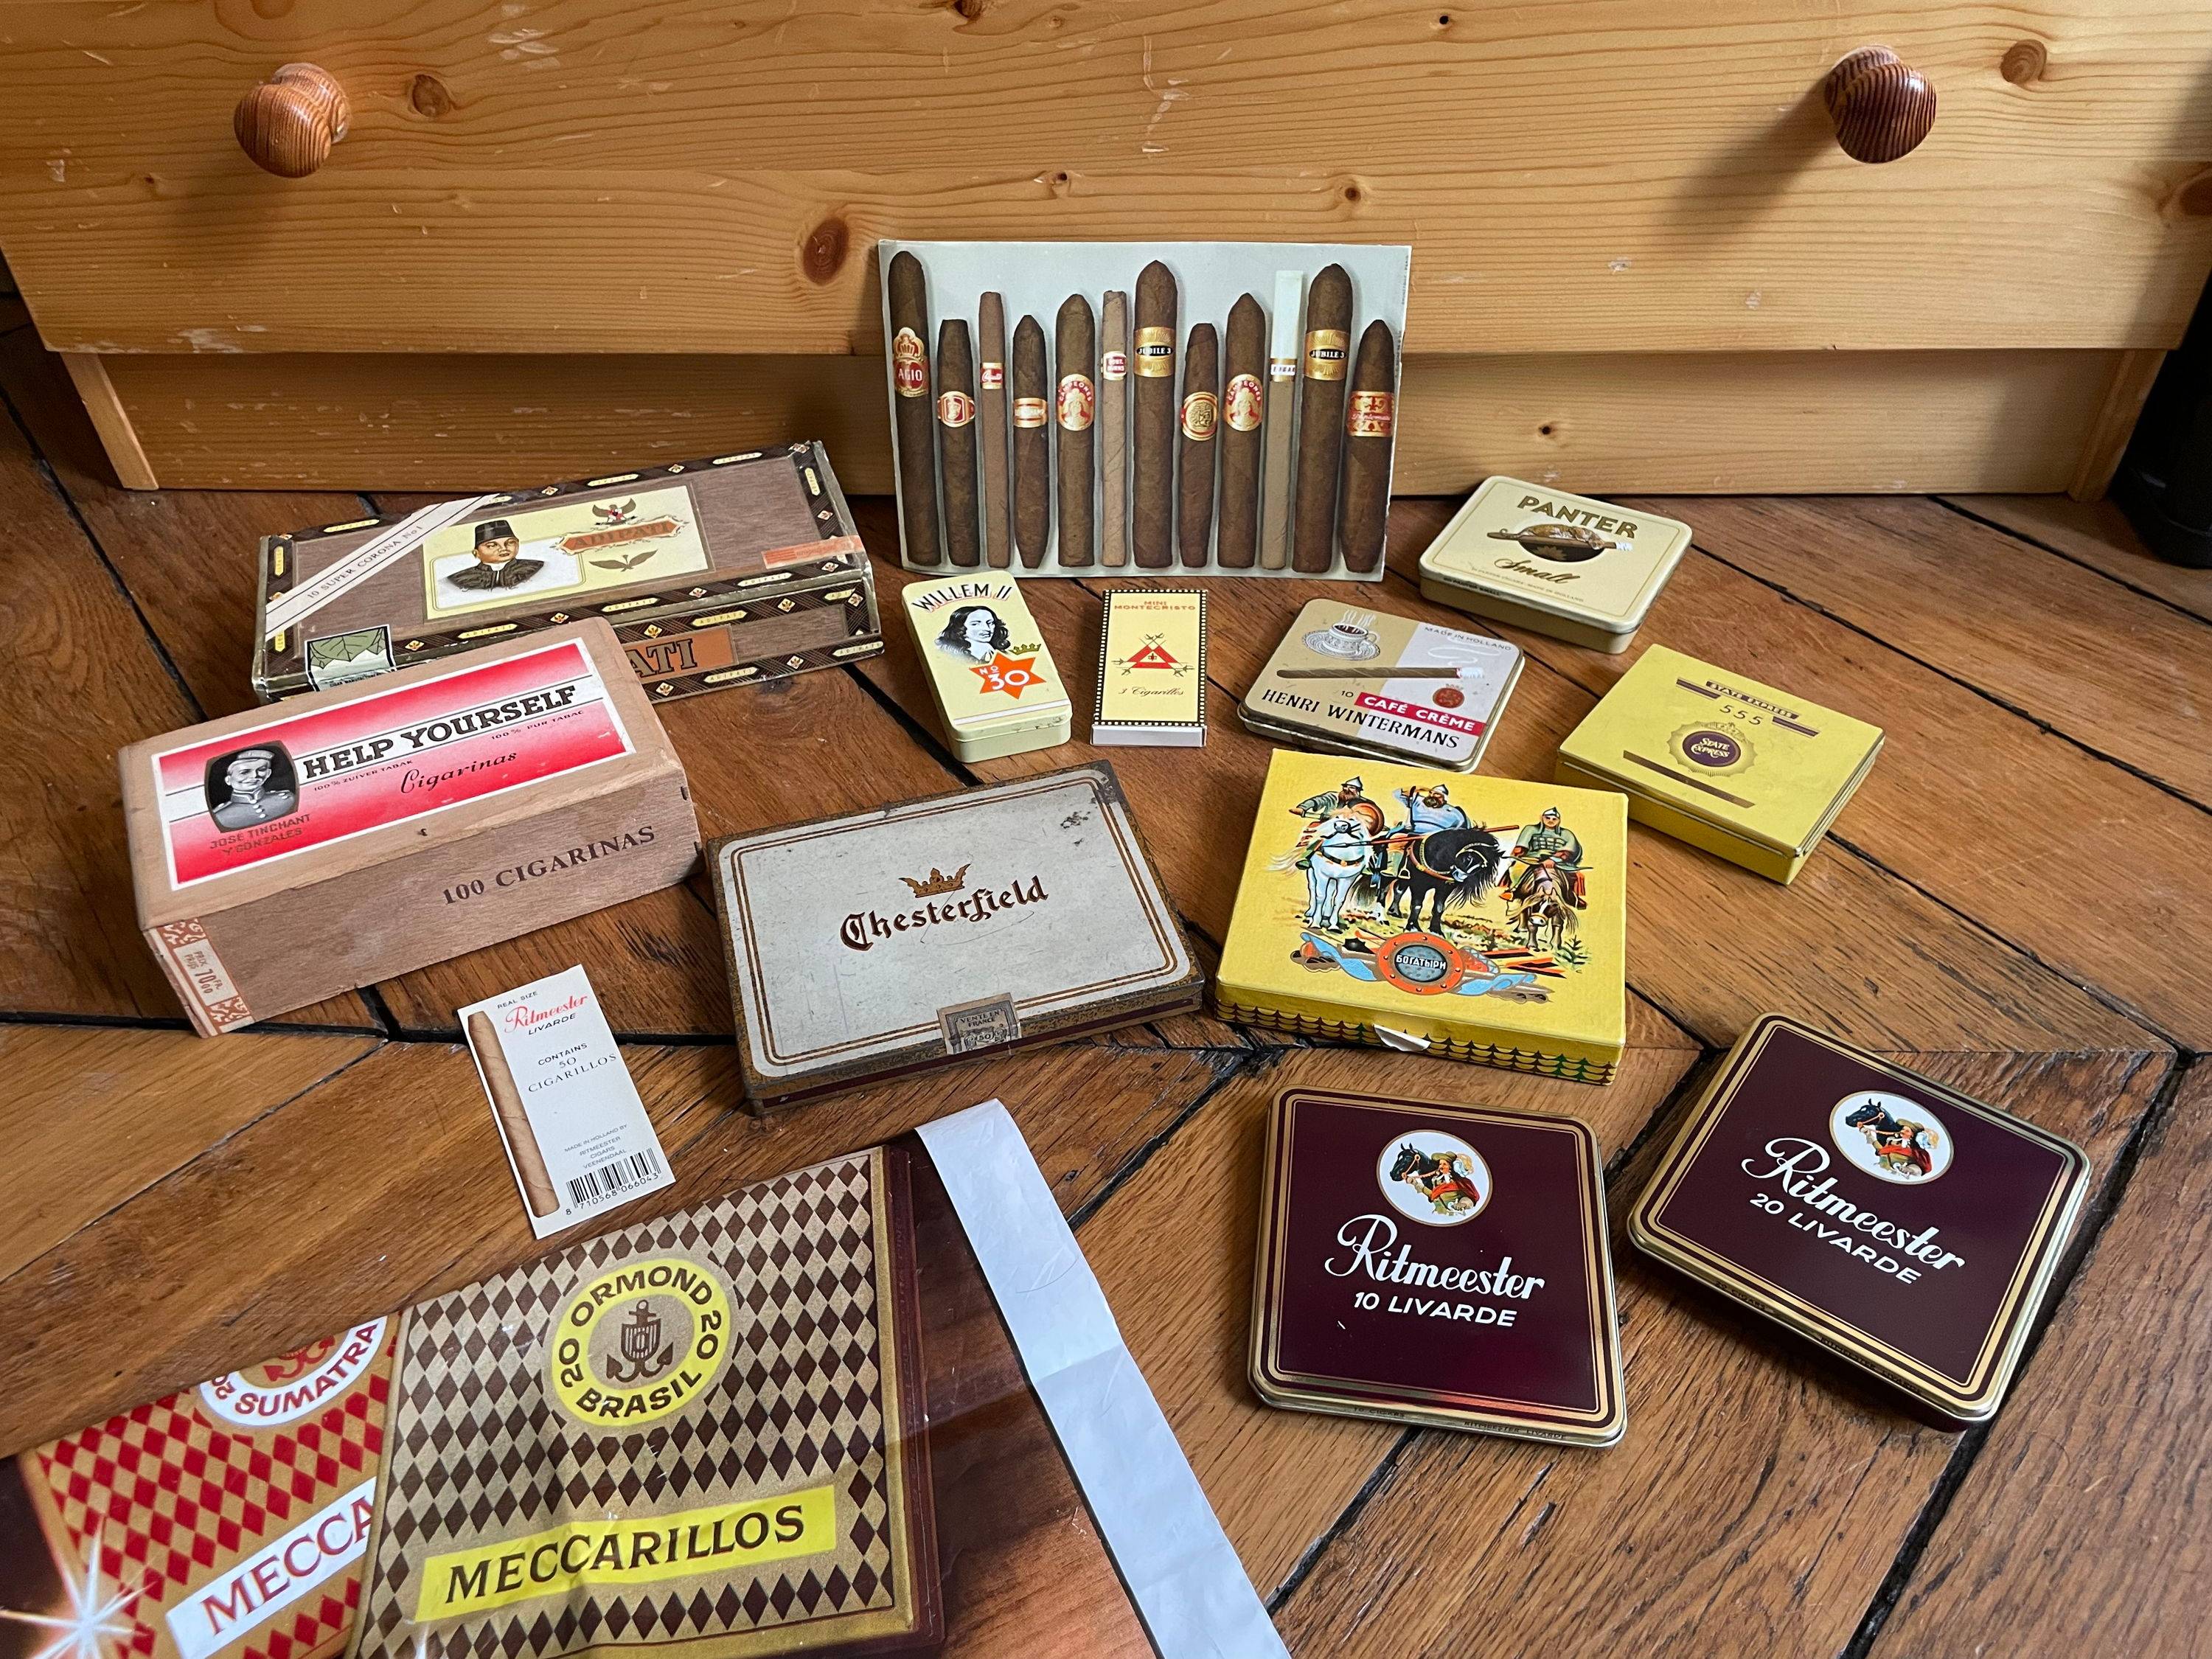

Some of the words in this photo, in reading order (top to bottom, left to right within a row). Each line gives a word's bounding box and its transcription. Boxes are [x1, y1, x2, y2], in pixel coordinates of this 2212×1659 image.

[897, 368, 922, 382] AGIO
[1057, 380, 1093, 402] CAMPEONES
[1517, 495, 1639, 540] PANTER
[321, 568, 355, 590] SUPER
[358, 541, 401, 567] CORONA
[1494, 557, 1581, 584] Small
[911, 583, 992, 611] WILLEM
[699, 611, 744, 625] ADIPATI
[1425, 627, 1453, 636] MADE
[1466, 636, 1512, 651] HOLLAND
[710, 668, 752, 681] ADIPATI
[988, 669, 1030, 690] 30
[1363, 695, 1409, 714] CAFÉ
[1415, 709, 1475, 731] CRÈME
[1710, 684, 1743, 698] STATE
[1747, 698, 1792, 717] EXPRESS
[303, 738, 394, 779] HELP
[400, 685, 576, 748] YOURSELF
[527, 721, 548, 729] PUR
[552, 710, 584, 722] TABAC
[1262, 689, 1321, 713] HENRI
[1326, 704, 1460, 749] WINTERMANS
[1691, 742, 1731, 758] EXPRESS
[1700, 737, 1731, 750] STATE
[343, 770, 378, 783] ZUIVER
[381, 760, 413, 771] TABAK
[400, 753, 517, 793] Cigarinas
[248, 814, 310, 838] TINCHANT
[236, 827, 303, 853] GONZALES
[443, 878, 485, 906] 100
[496, 825, 656, 888] CIGARINAS
[841, 875, 1048, 951] Chesterfield
[1395, 953, 1447, 970] БОГАТЫРИ
[497, 998, 518, 1009] REAL
[521, 990, 538, 1002] SIZE
[504, 995, 588, 1034] Ritmeester
[528, 1012, 576, 1035] LIVARDE
[960, 1012, 987, 1023] VENTE
[990, 1010, 1000, 1018] EN
[967, 1017, 995, 1027] FRANCE
[538, 1043, 588, 1065] CONTAINS
[560, 1057, 577, 1068] 50
[528, 1053, 617, 1092] CIGARILLOS
[564, 1143, 582, 1152] MADE
[591, 1129, 619, 1141] HOLLAND
[580, 1136, 621, 1155] RITMEESTER
[590, 1146, 616, 1158] CIGARS
[1741, 1138, 1965, 1271] Ritmeester
[1750, 1193, 1785, 1214] 20
[1787, 1211, 1922, 1284] LIVARDE
[1325, 1214, 1545, 1299] Ritmeester
[572, 1265, 713, 1327] ORMOND
[696, 1308, 723, 1360] 20
[1354, 1292, 1380, 1310] 10
[1387, 1295, 1517, 1326] LIVARDE
[234, 1323, 378, 1416] SUMATRA
[560, 1339, 585, 1388] 20
[576, 1368, 703, 1418] BRASIL
[201, 1498, 375, 1635] MECCA
[445, 1505, 805, 1604] MECCARILLOS
